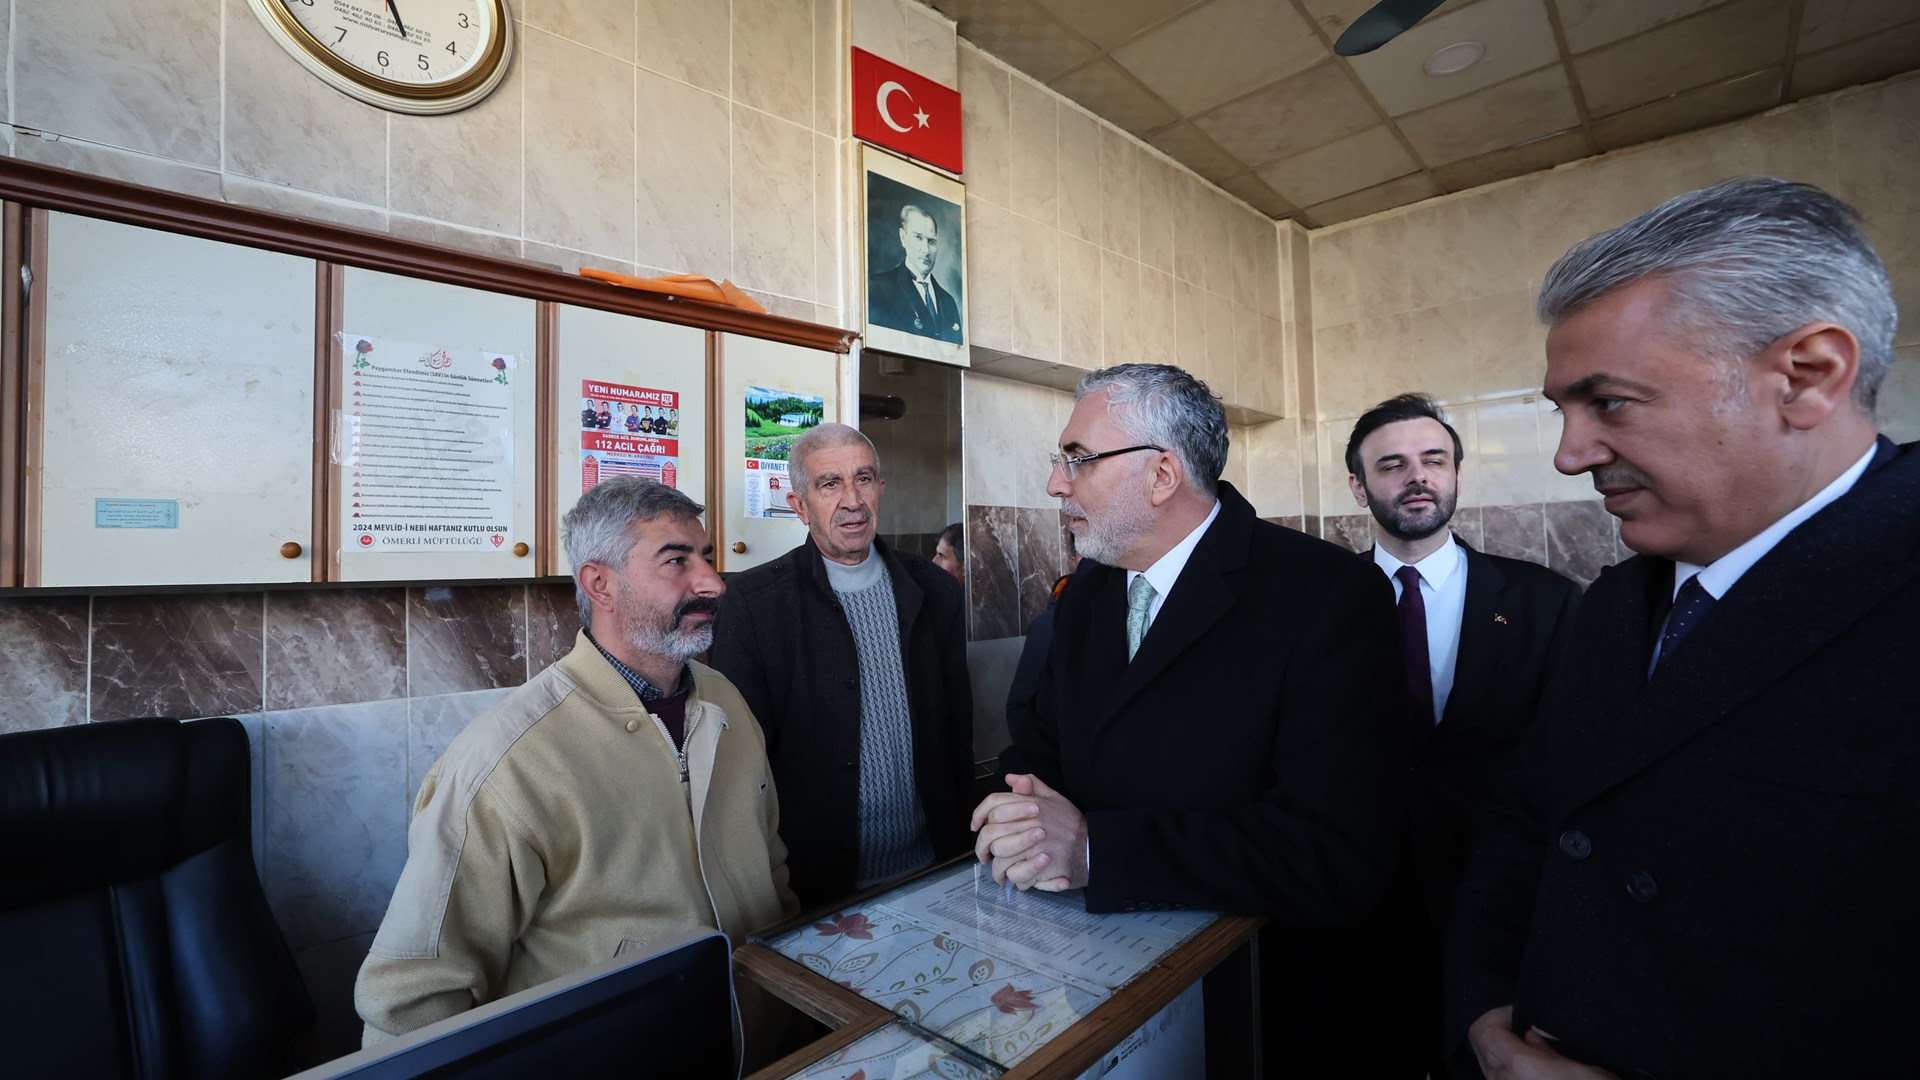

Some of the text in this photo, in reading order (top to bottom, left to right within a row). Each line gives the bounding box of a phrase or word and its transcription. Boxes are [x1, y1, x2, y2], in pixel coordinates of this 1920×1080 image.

[457, 13, 470, 29] 3
[334, 26, 348, 43] 7
[445, 41, 458, 56] 4
[377, 51, 390, 67] 6
[417, 54, 429, 71] 5
[610, 388, 660, 400] NUMARAMIZ
[595, 440, 612, 449] 112
[637, 443, 665, 454] ÇAĞRI
[374, 523, 408, 531] MEVLİD-İ
[409, 523, 427, 531] NEBİ
[428, 524, 462, 532] HAFTANIZ
[382, 536, 482, 545] ÖMERLİ MÜFTÜLÜĞÜ
